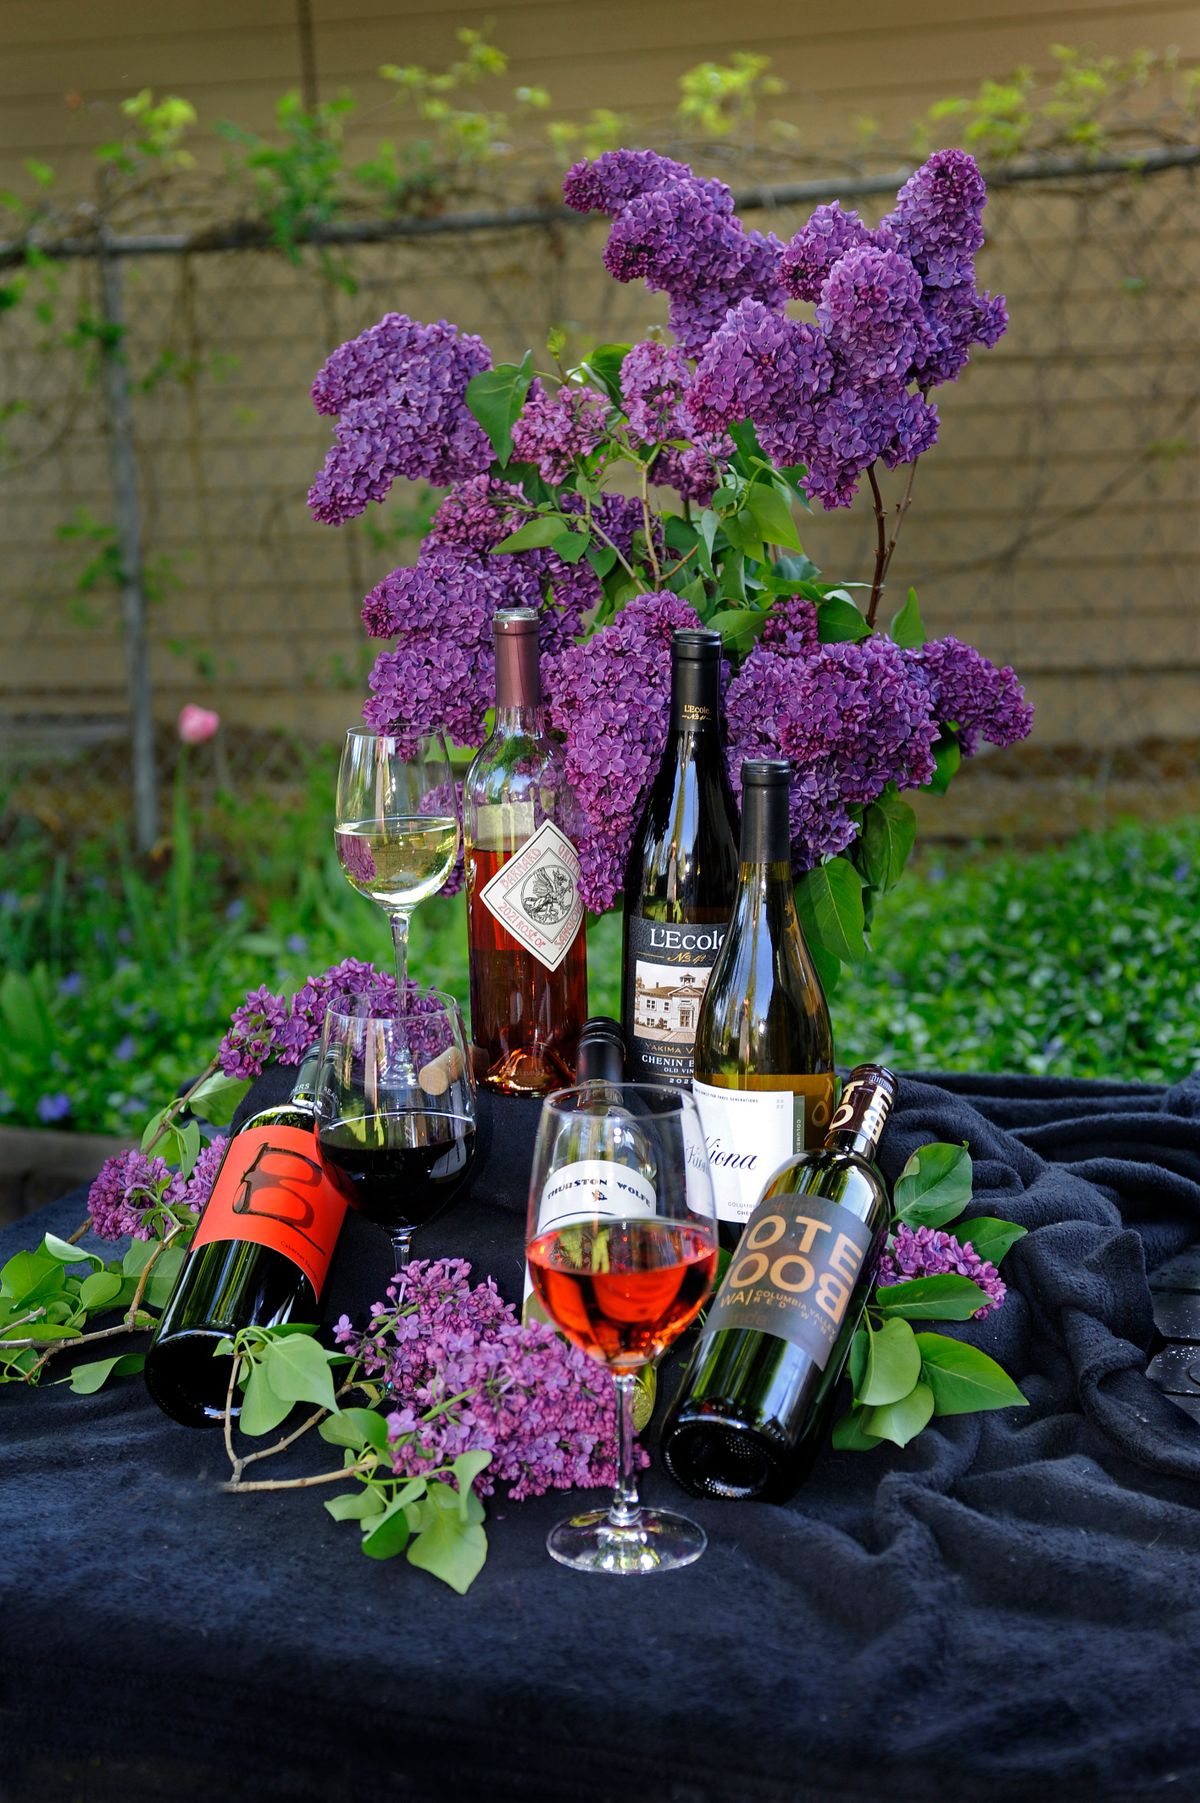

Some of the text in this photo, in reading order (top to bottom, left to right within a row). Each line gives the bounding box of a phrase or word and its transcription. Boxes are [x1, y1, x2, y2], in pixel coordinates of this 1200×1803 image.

[684, 704, 710, 714] L'Ecole
[499, 848, 542, 890] BARNARD
[498, 902, 519, 924] 2021
[645, 1042, 682, 1054] YAKIMA
[641, 1054, 683, 1067] CHENIN
[547, 1179, 651, 1208] THURSTON WOLFE
[755, 1290, 806, 1310] COLUMBIA
